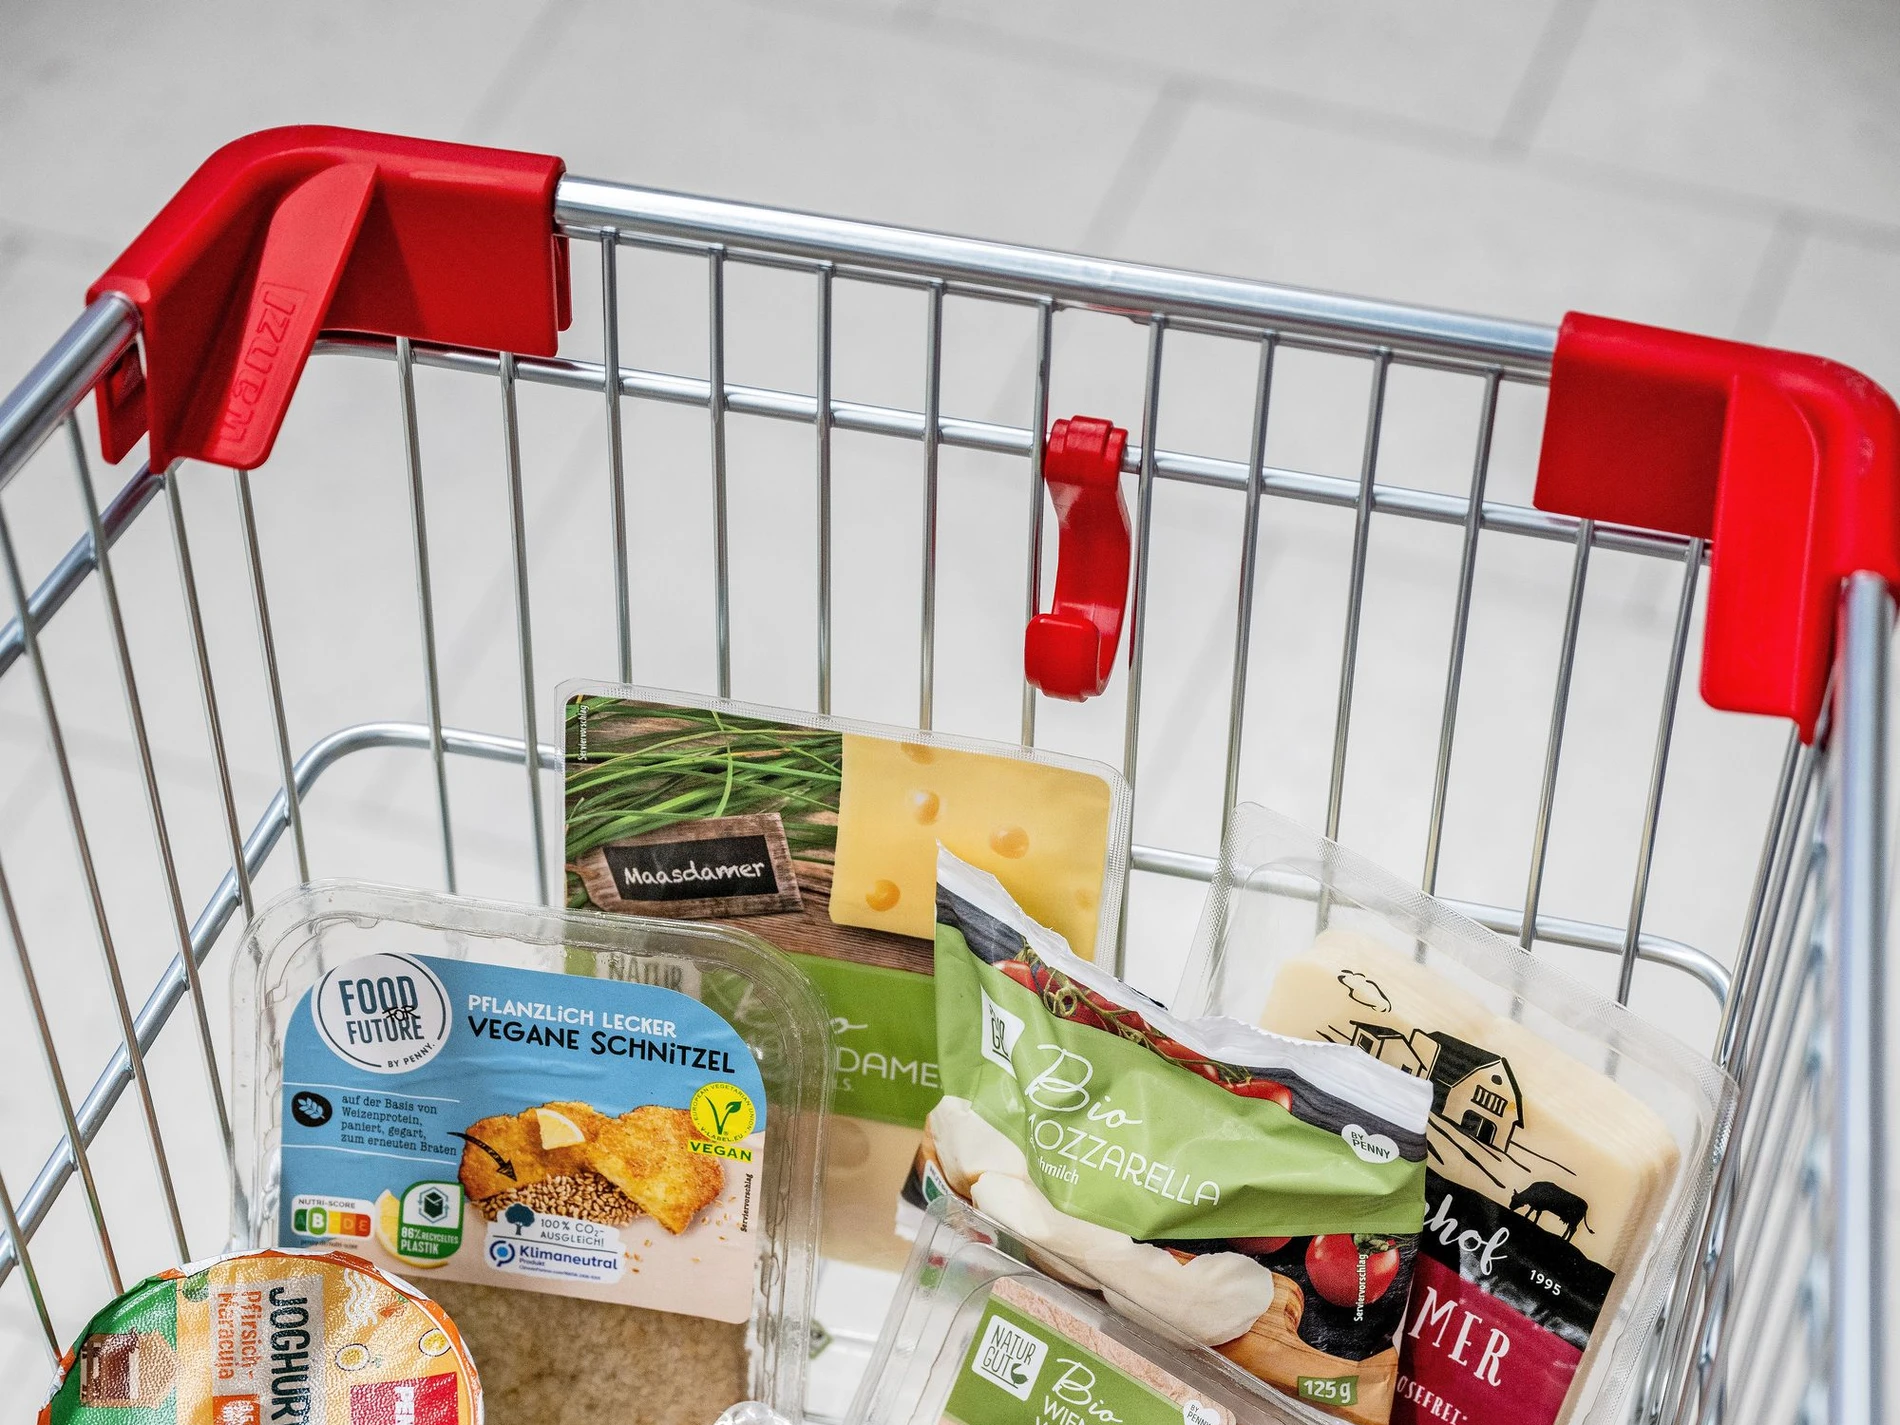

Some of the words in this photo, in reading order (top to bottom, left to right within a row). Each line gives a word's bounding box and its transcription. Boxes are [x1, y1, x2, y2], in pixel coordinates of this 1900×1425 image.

[577, 705, 590, 761] Serviervorschlag
[624, 860, 765, 885] Maasdamer
[338, 975, 419, 1016] FOOD
[382, 1005, 421, 1022] FOR
[603, 1012, 676, 1038] LECKER
[346, 1016, 424, 1045] FUTURE
[468, 1015, 580, 1050] VEGANE
[387, 1060, 399, 1068] BY
[1025, 1043, 1143, 1128] Bio
[342, 1095, 361, 1105] auf
[363, 1096, 381, 1107] der
[385, 1099, 414, 1111] Basis
[418, 1105, 437, 1115] von
[342, 1107, 423, 1126] Weizenprotein,
[692, 1087, 709, 1121] EUROPEAN
[711, 1084, 751, 1106] VEGETARIAN
[747, 1107, 755, 1131] UNION
[341, 1121, 385, 1135] paniert,
[388, 1127, 427, 1140] gegart,
[1351, 1131, 1363, 1141] BY
[341, 1134, 364, 1144] zum
[367, 1137, 417, 1150] erneuten
[420, 1142, 457, 1156] Braten
[690, 1142, 752, 1162] VEGAN
[1352, 1139, 1390, 1159] PENNY
[1038, 1157, 1080, 1186] hmilch
[298, 1199, 356, 1209] NUTRI-SCORE
[740, 1173, 753, 1233] Serviervorschlag
[312, 1214, 324, 1228] B
[401, 1240, 439, 1254] PLASTIK
[520, 1245, 618, 1270] Klimaneutral
[1354, 1254, 1368, 1321] Serviervorschlag
[1529, 1269, 1561, 1296] 1995
[990, 1325, 1037, 1366] NATUR
[983, 1347, 1014, 1375] GUT
[1052, 1358, 1123, 1424] Bio
[1190, 1404, 1200, 1413] BY
